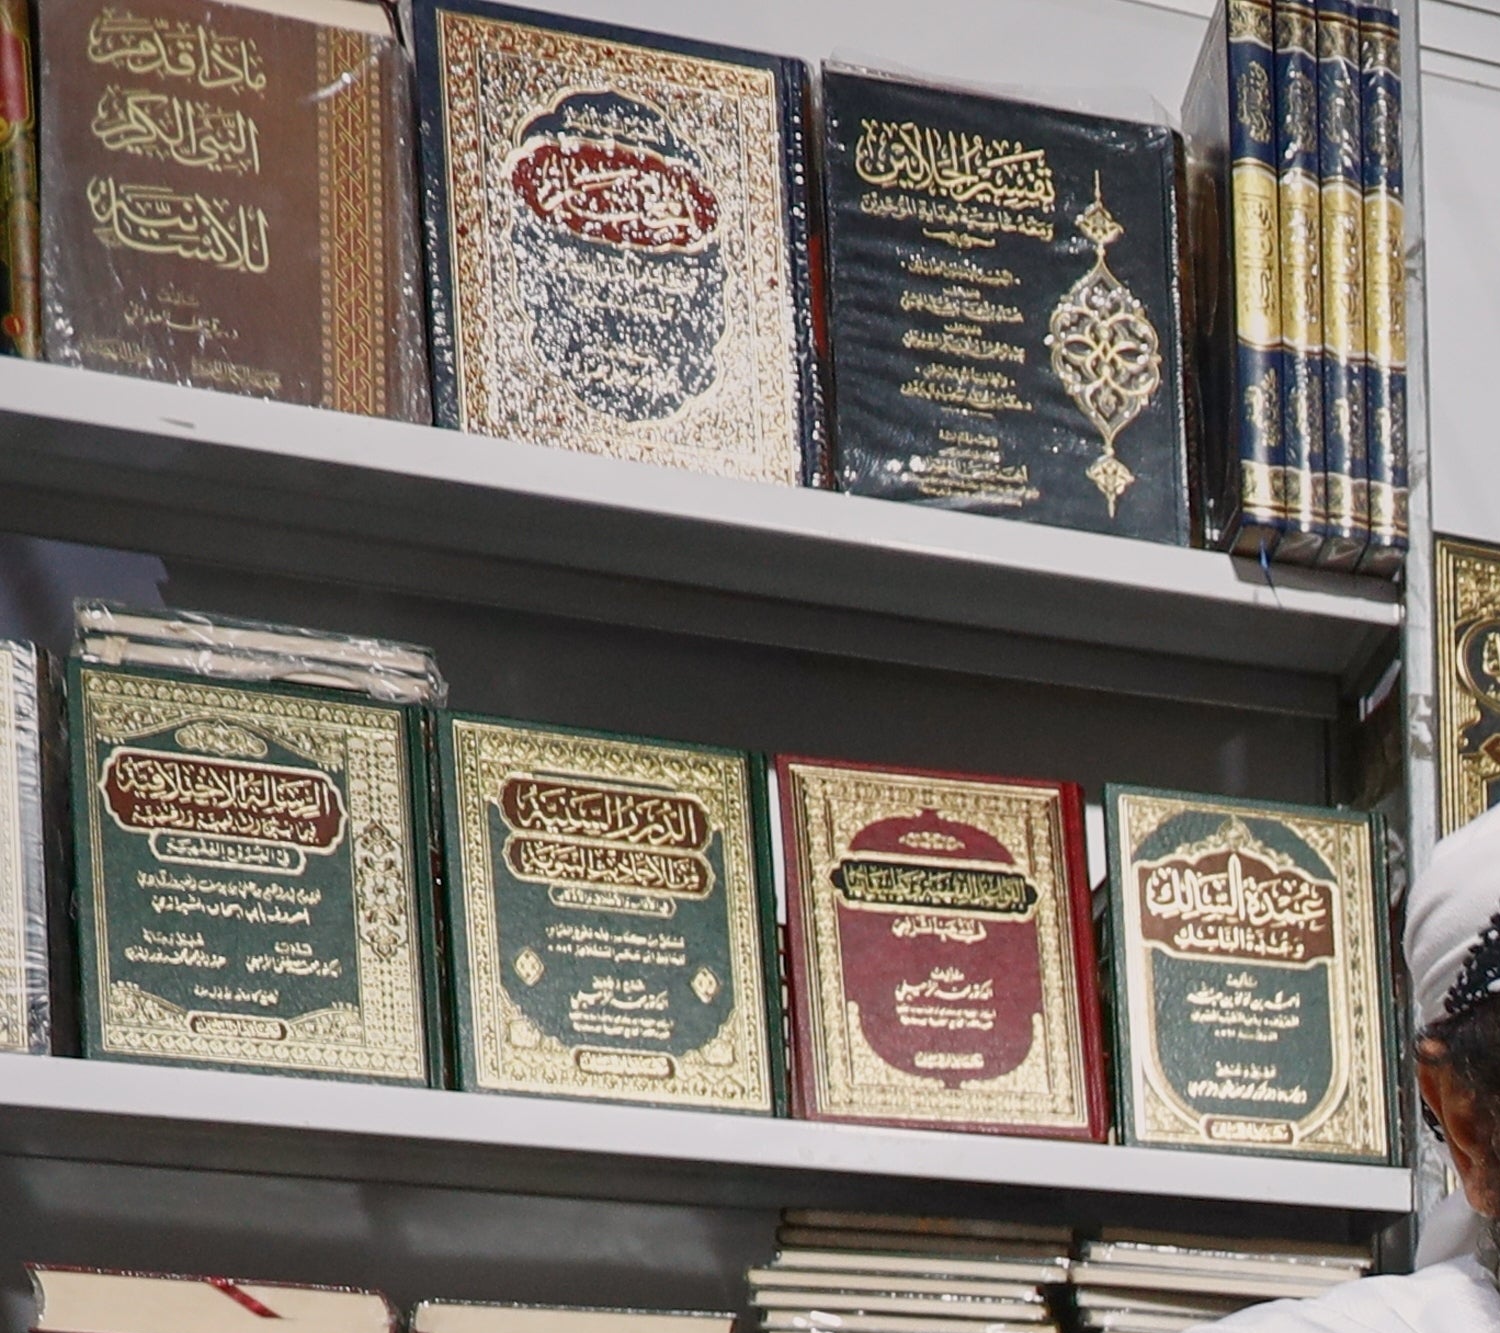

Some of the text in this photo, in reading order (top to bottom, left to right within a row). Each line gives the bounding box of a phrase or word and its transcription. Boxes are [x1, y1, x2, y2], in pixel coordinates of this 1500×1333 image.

[198, 24, 267, 98] ماذا
[91, 86, 260, 175] النبي الكريم
[855, 119, 1056, 213] تفسير الجلالين
[1145, 853, 1327, 932] عمدة السالك
